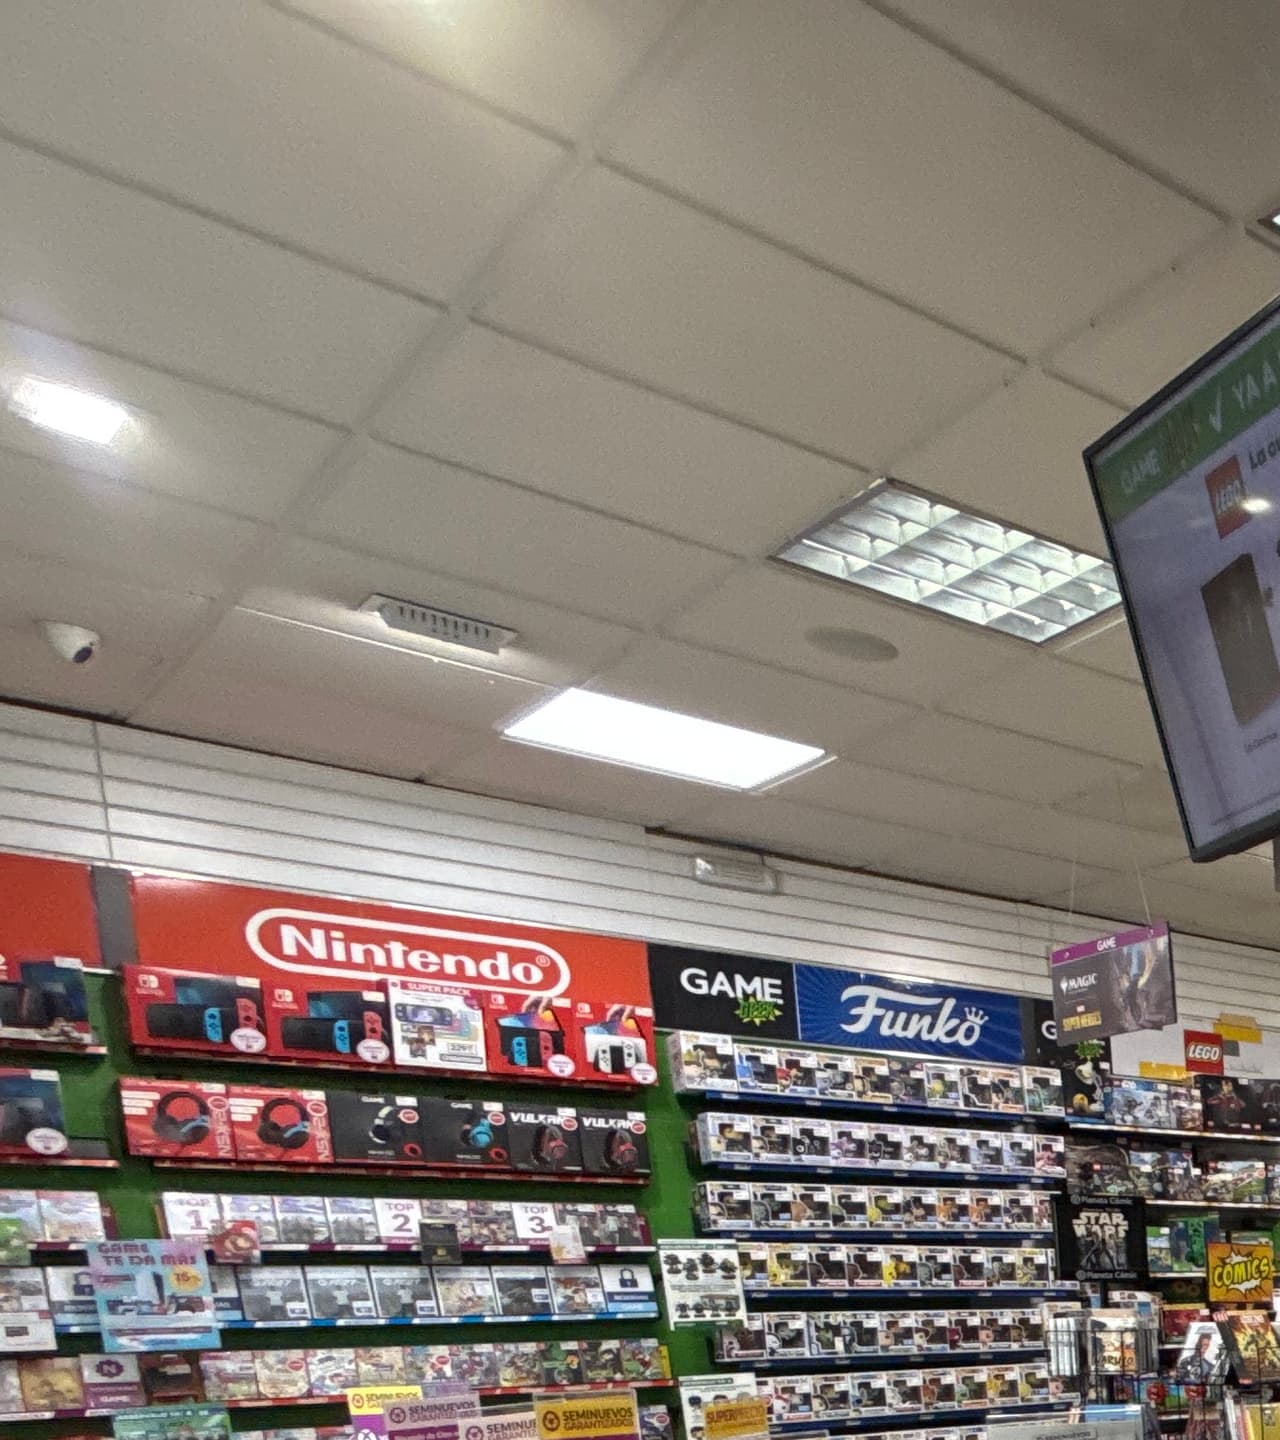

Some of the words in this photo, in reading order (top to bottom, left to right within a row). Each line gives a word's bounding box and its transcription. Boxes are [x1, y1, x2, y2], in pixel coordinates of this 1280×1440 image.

[1233, 373, 1261, 413] YA
[1262, 361, 1279, 392] A
[1096, 936, 1116, 951] GAME
[279, 922, 544, 986] Nintendo
[680, 967, 782, 1004] GAME
[1067, 973, 1097, 991] MAGIC
[840, 984, 982, 1047] Funko
[1187, 1044, 1220, 1061] LEGO
[385, 1202, 415, 1212] TOP
[522, 1205, 548, 1214] TOP
[393, 1213, 413, 1232] 2
[529, 1217, 545, 1233] 3
[1072, 1210, 1126, 1227] STAR
[1072, 1224, 1128, 1240] WARS
[1213, 1258, 1270, 1288] COMICS
[408, 1400, 476, 1414] SEMINUEVOS
[562, 1406, 633, 1421] SEMINUEVOS
[563, 1417, 632, 1431] GARANTIZADOS
